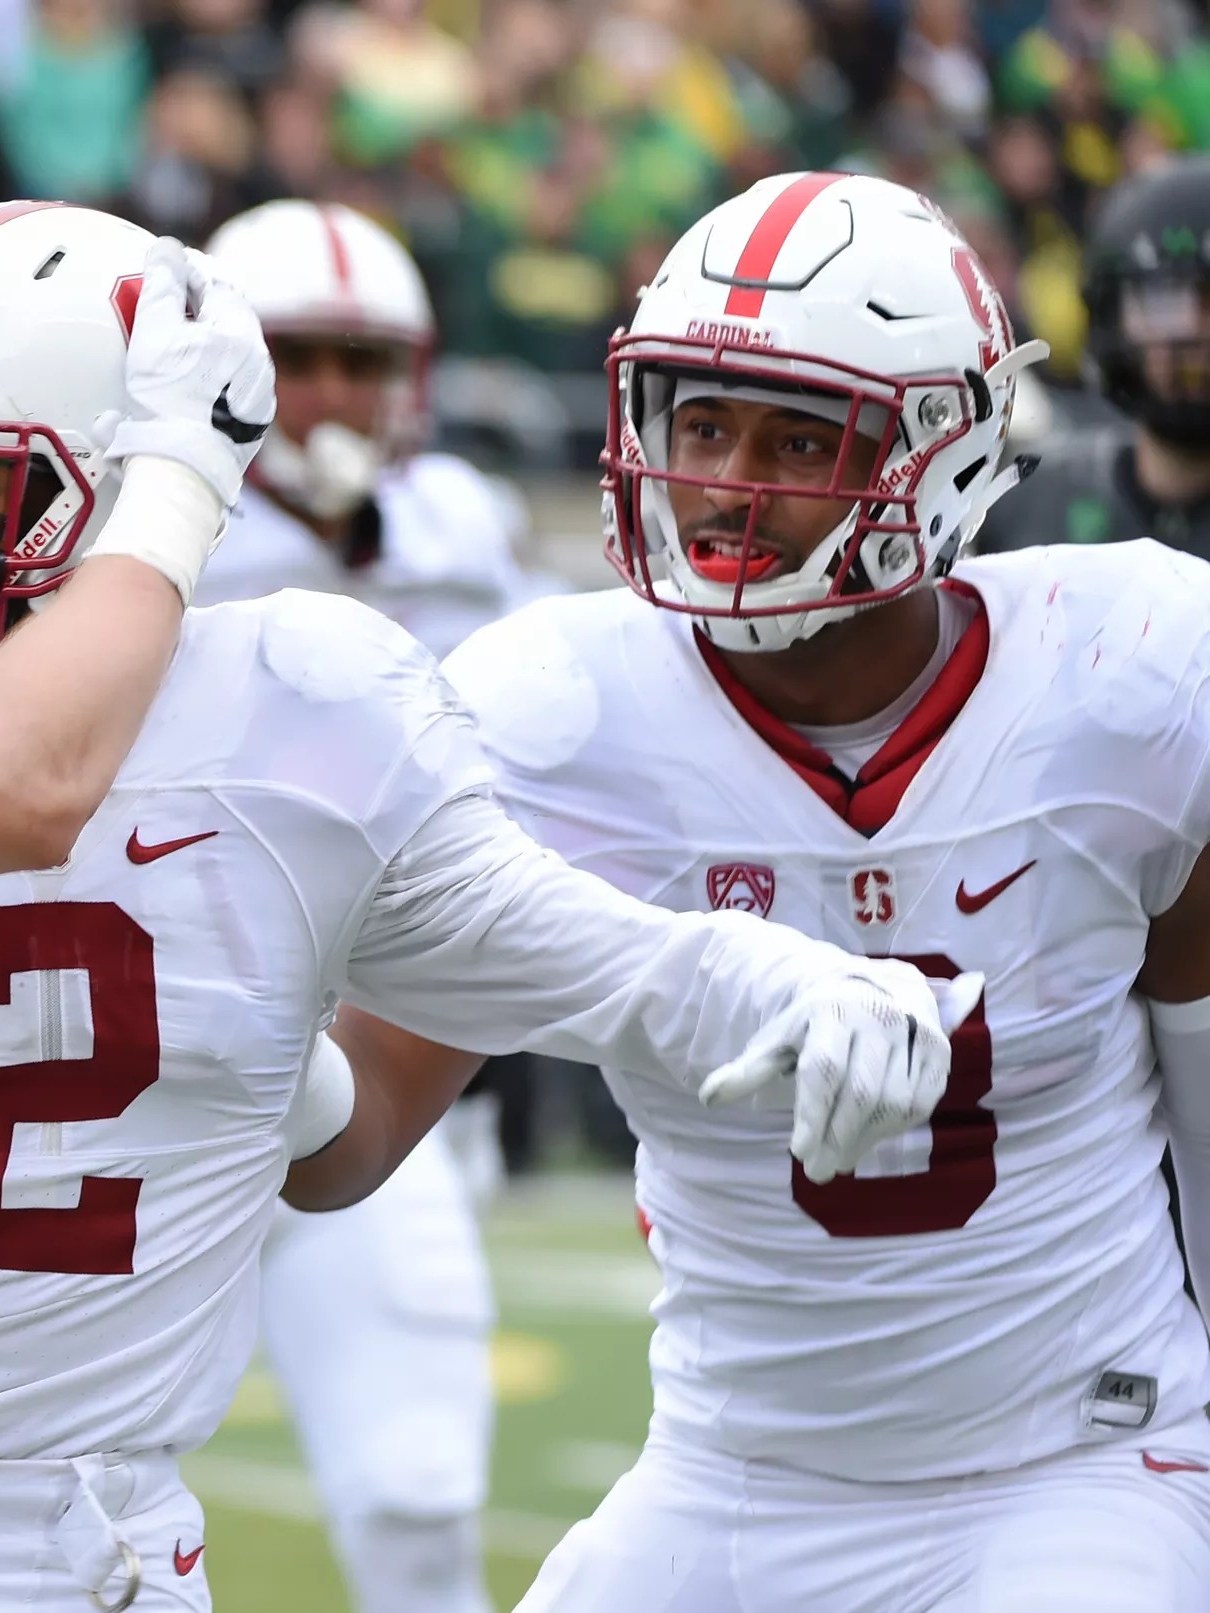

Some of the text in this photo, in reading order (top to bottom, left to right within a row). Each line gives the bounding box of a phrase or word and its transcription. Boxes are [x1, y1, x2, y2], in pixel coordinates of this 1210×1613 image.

[686, 320, 774, 348] CARDINAL
[879, 450, 923, 494] ddell
[16, 517, 58, 558] dell
[1109, 1381, 1134, 1399] 44
